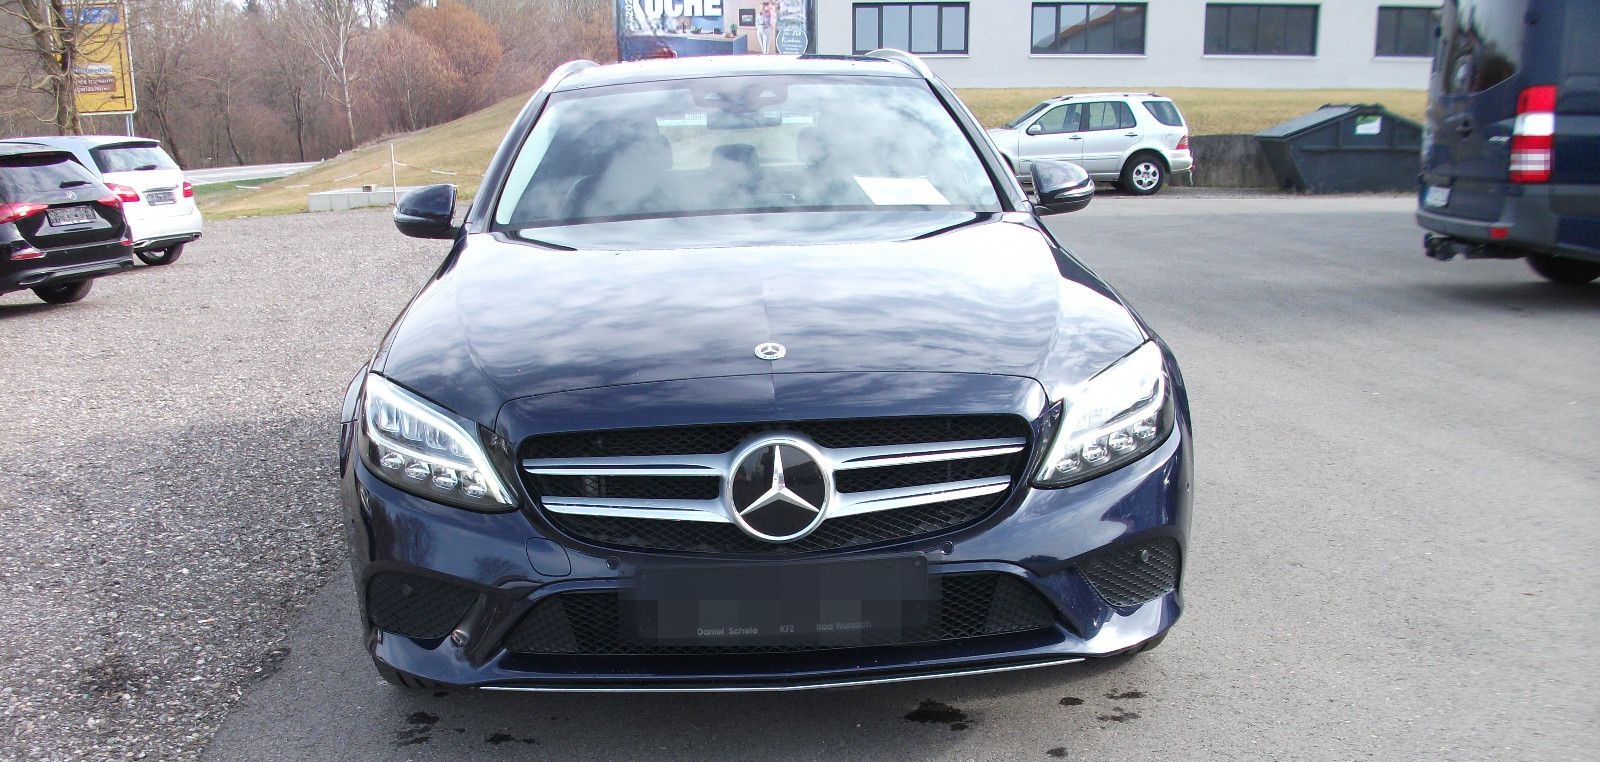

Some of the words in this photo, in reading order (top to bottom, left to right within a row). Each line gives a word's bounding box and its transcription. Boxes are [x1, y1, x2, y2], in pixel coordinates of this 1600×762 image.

[697, 627, 725, 636] Daniel
[728, 626, 759, 635] Schele
[780, 624, 795, 633] KFZ
[816, 622, 834, 631] Bad
[835, 620, 872, 630] Wurzach
